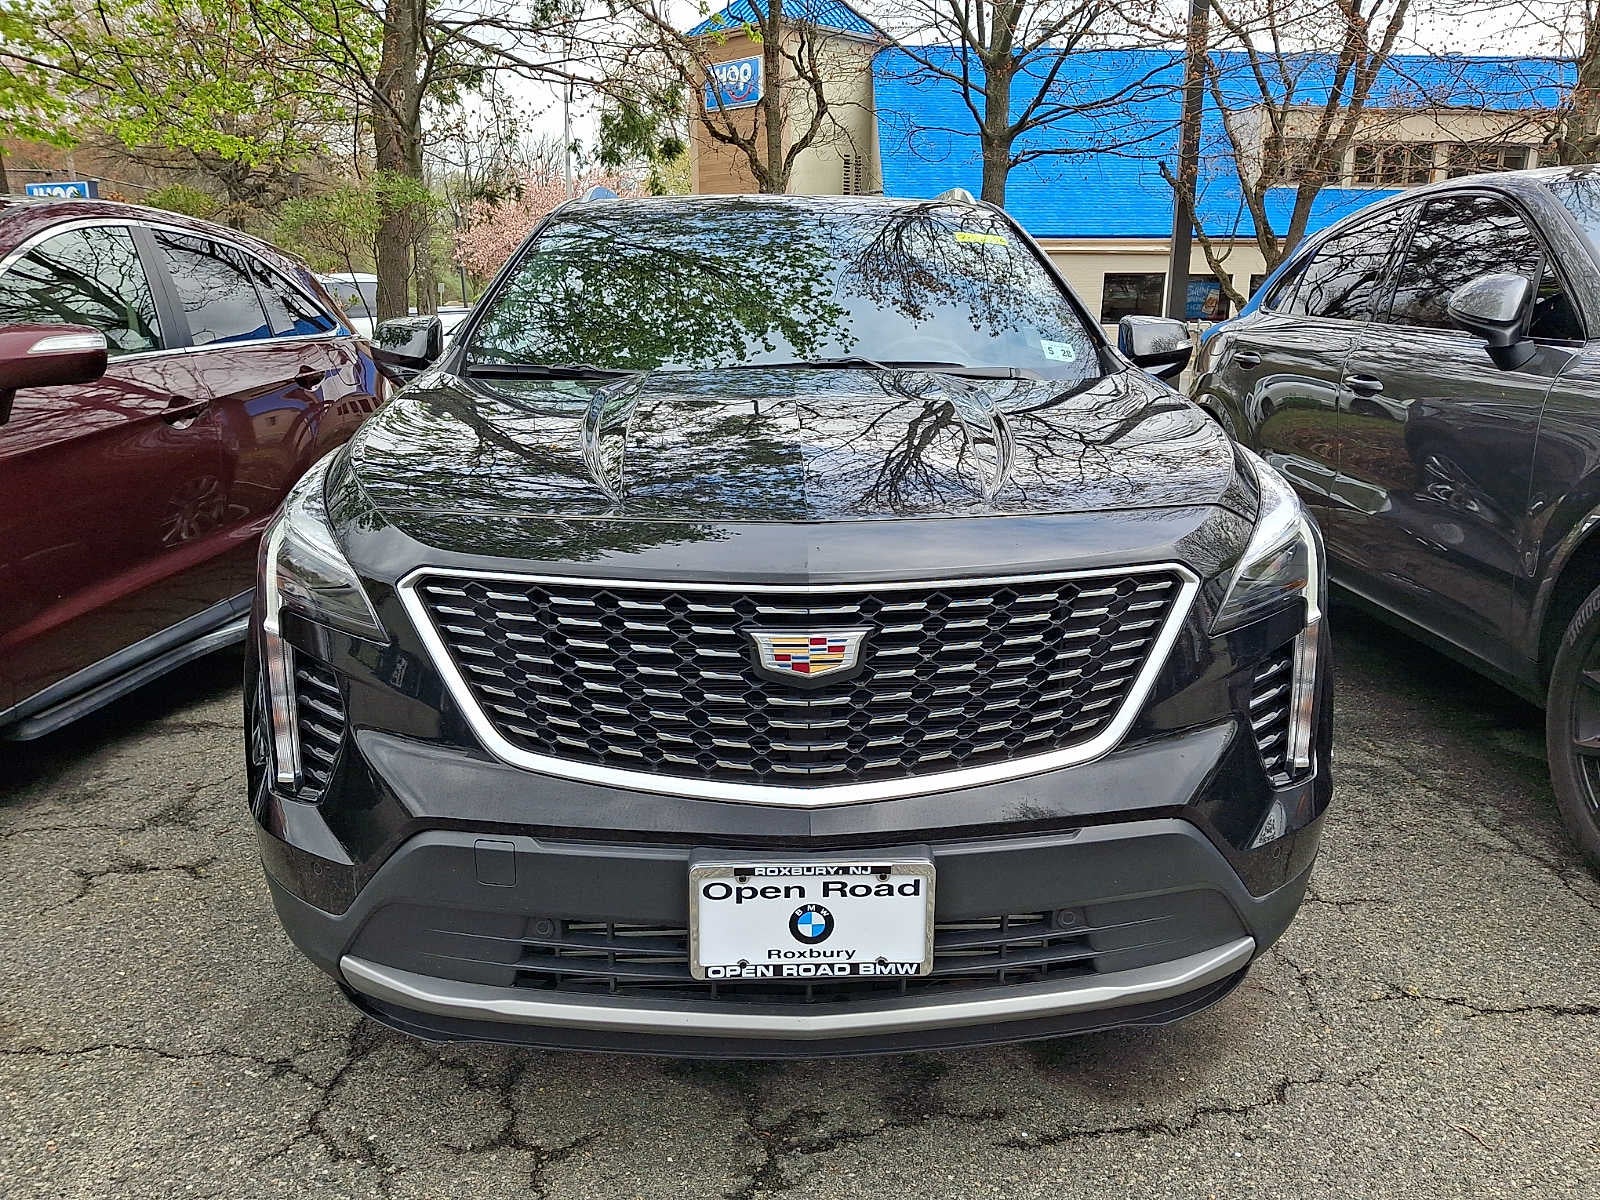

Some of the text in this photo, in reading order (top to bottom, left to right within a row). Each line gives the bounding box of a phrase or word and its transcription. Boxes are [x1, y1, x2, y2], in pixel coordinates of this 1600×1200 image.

[754, 866, 872, 876] ROXBURY, NJ
[702, 879, 920, 904] Open Road
[794, 904, 830, 917] BMW
[767, 948, 857, 960] Roxbury
[707, 962, 918, 978] OPEN ROAD BMW
